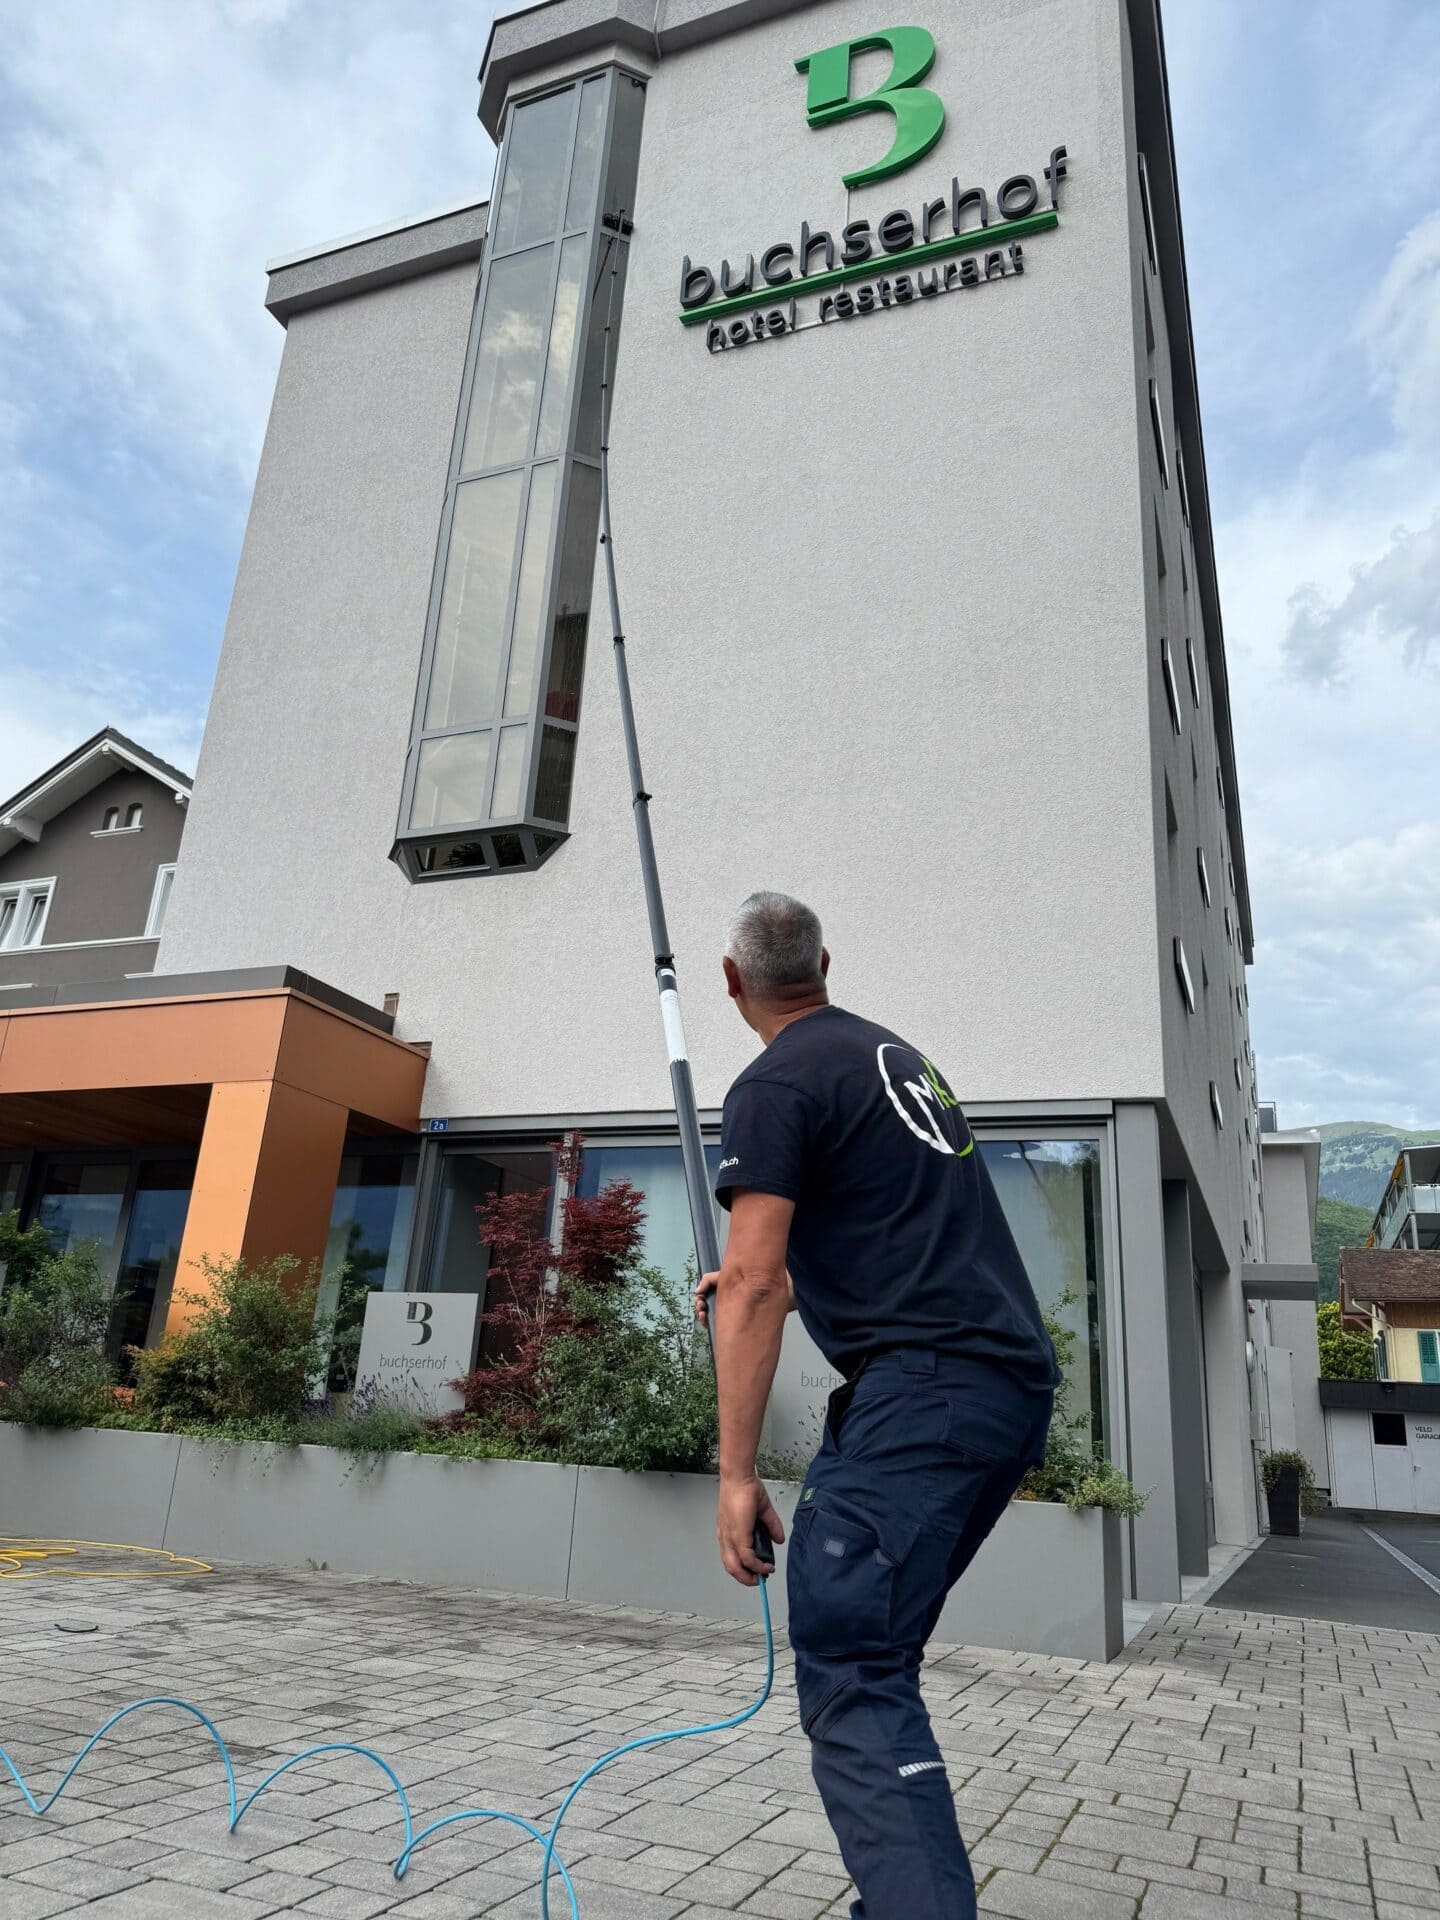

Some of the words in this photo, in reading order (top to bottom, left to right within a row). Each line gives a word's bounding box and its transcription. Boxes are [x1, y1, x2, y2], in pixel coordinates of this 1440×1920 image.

[794, 25, 946, 190] B
[680, 145, 1068, 309] buchserhof
[706, 297, 797, 354] hotel
[818, 241, 1025, 322] restaurant
[433, 1121, 445, 1130] 2a
[405, 1301, 433, 1346] B
[379, 1353, 448, 1370] buchserhof
[800, 1369, 845, 1388] buchs
[1414, 1425, 1433, 1433] VELO
